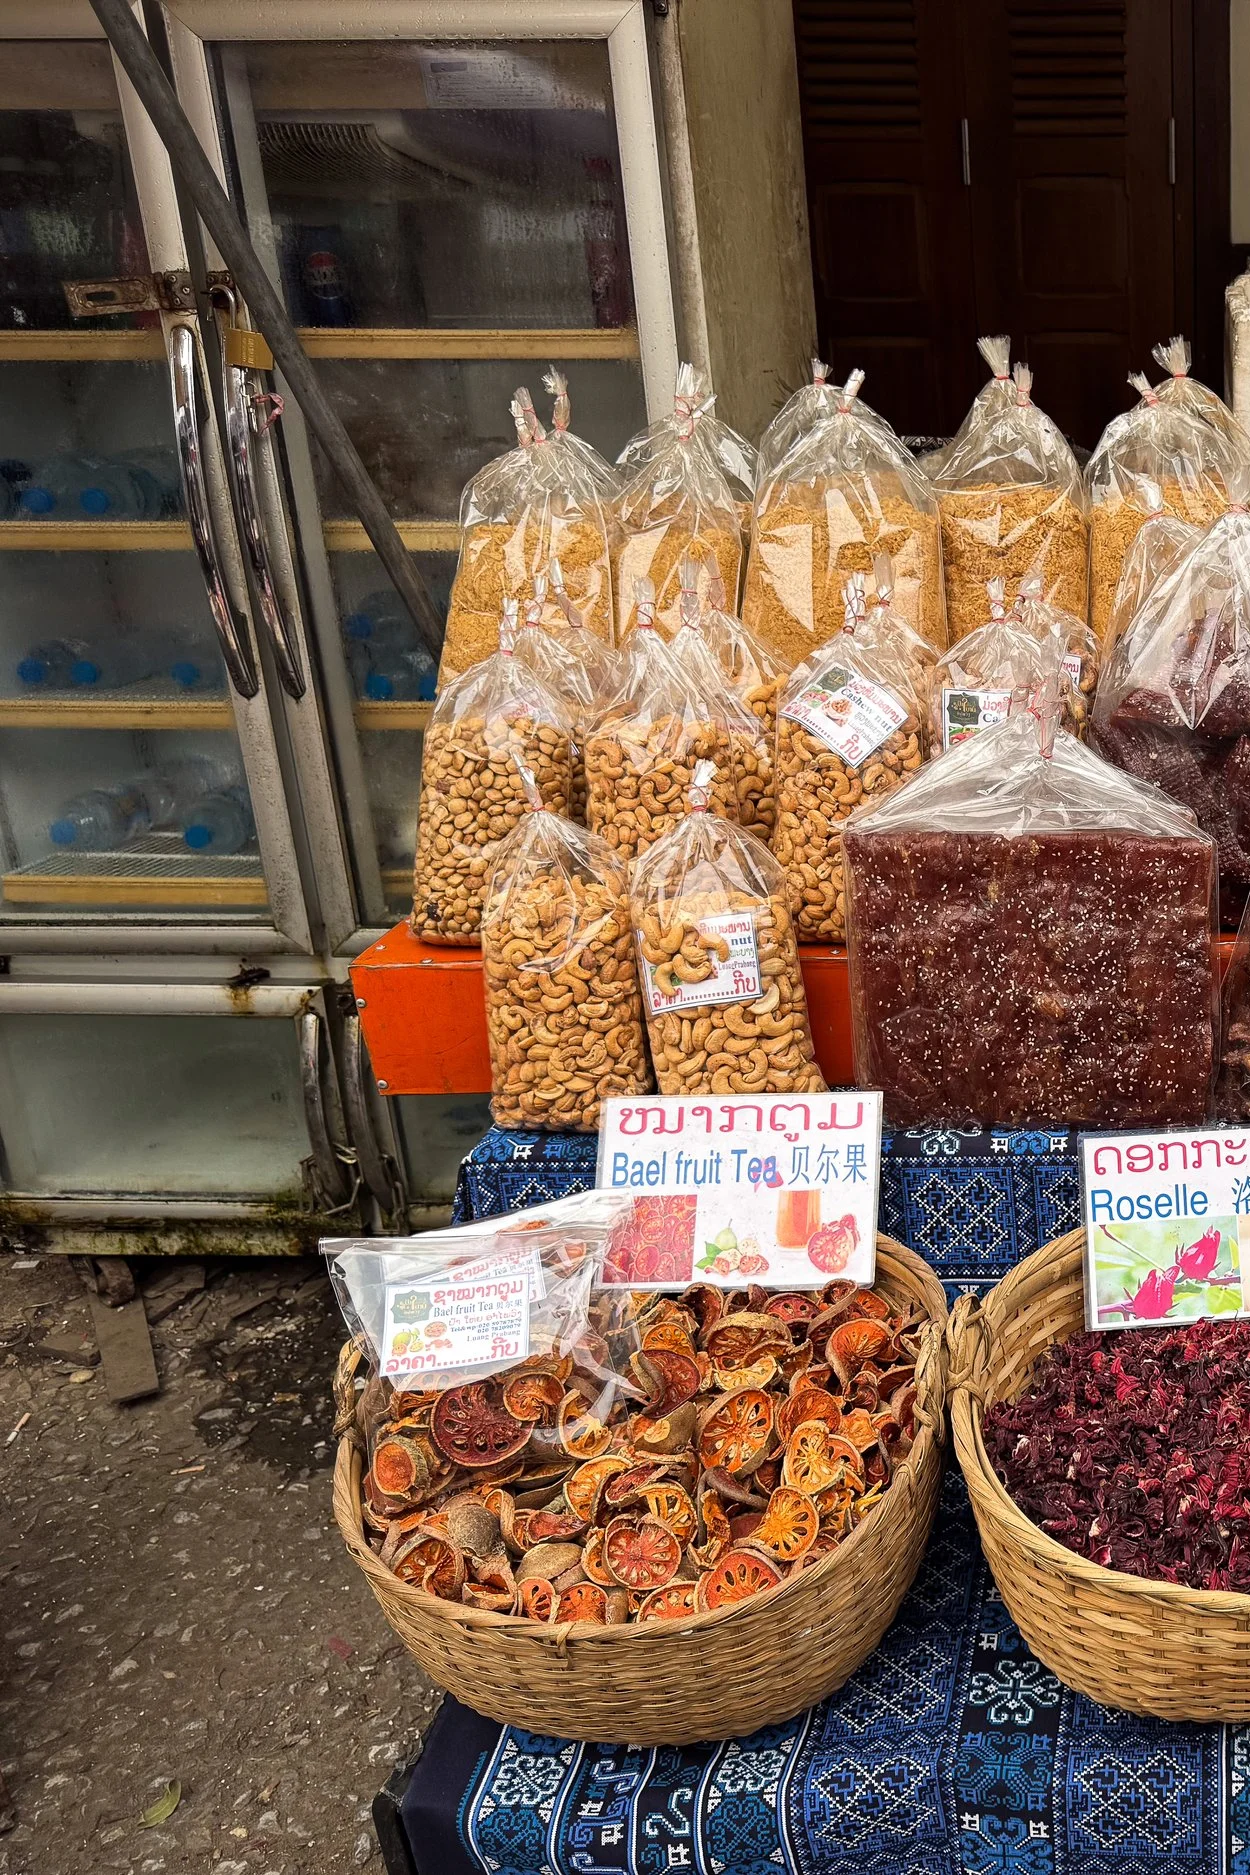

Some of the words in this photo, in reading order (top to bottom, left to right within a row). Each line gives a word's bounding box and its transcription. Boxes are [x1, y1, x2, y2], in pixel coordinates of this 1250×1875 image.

[841, 688, 873, 714] Cashew
[876, 715, 893, 732] nut
[731, 935, 753, 946] nut
[612, 1152, 666, 1187] Bael
[675, 1150, 721, 1184] fruit
[731, 1149, 776, 1184] Tea
[788, 1143, 867, 1186] 贝尔果
[1091, 1184, 1208, 1222] Roselle
[434, 1306, 453, 1317] Bael
[456, 1303, 475, 1315] fruit
[478, 1301, 493, 1311] Tea
